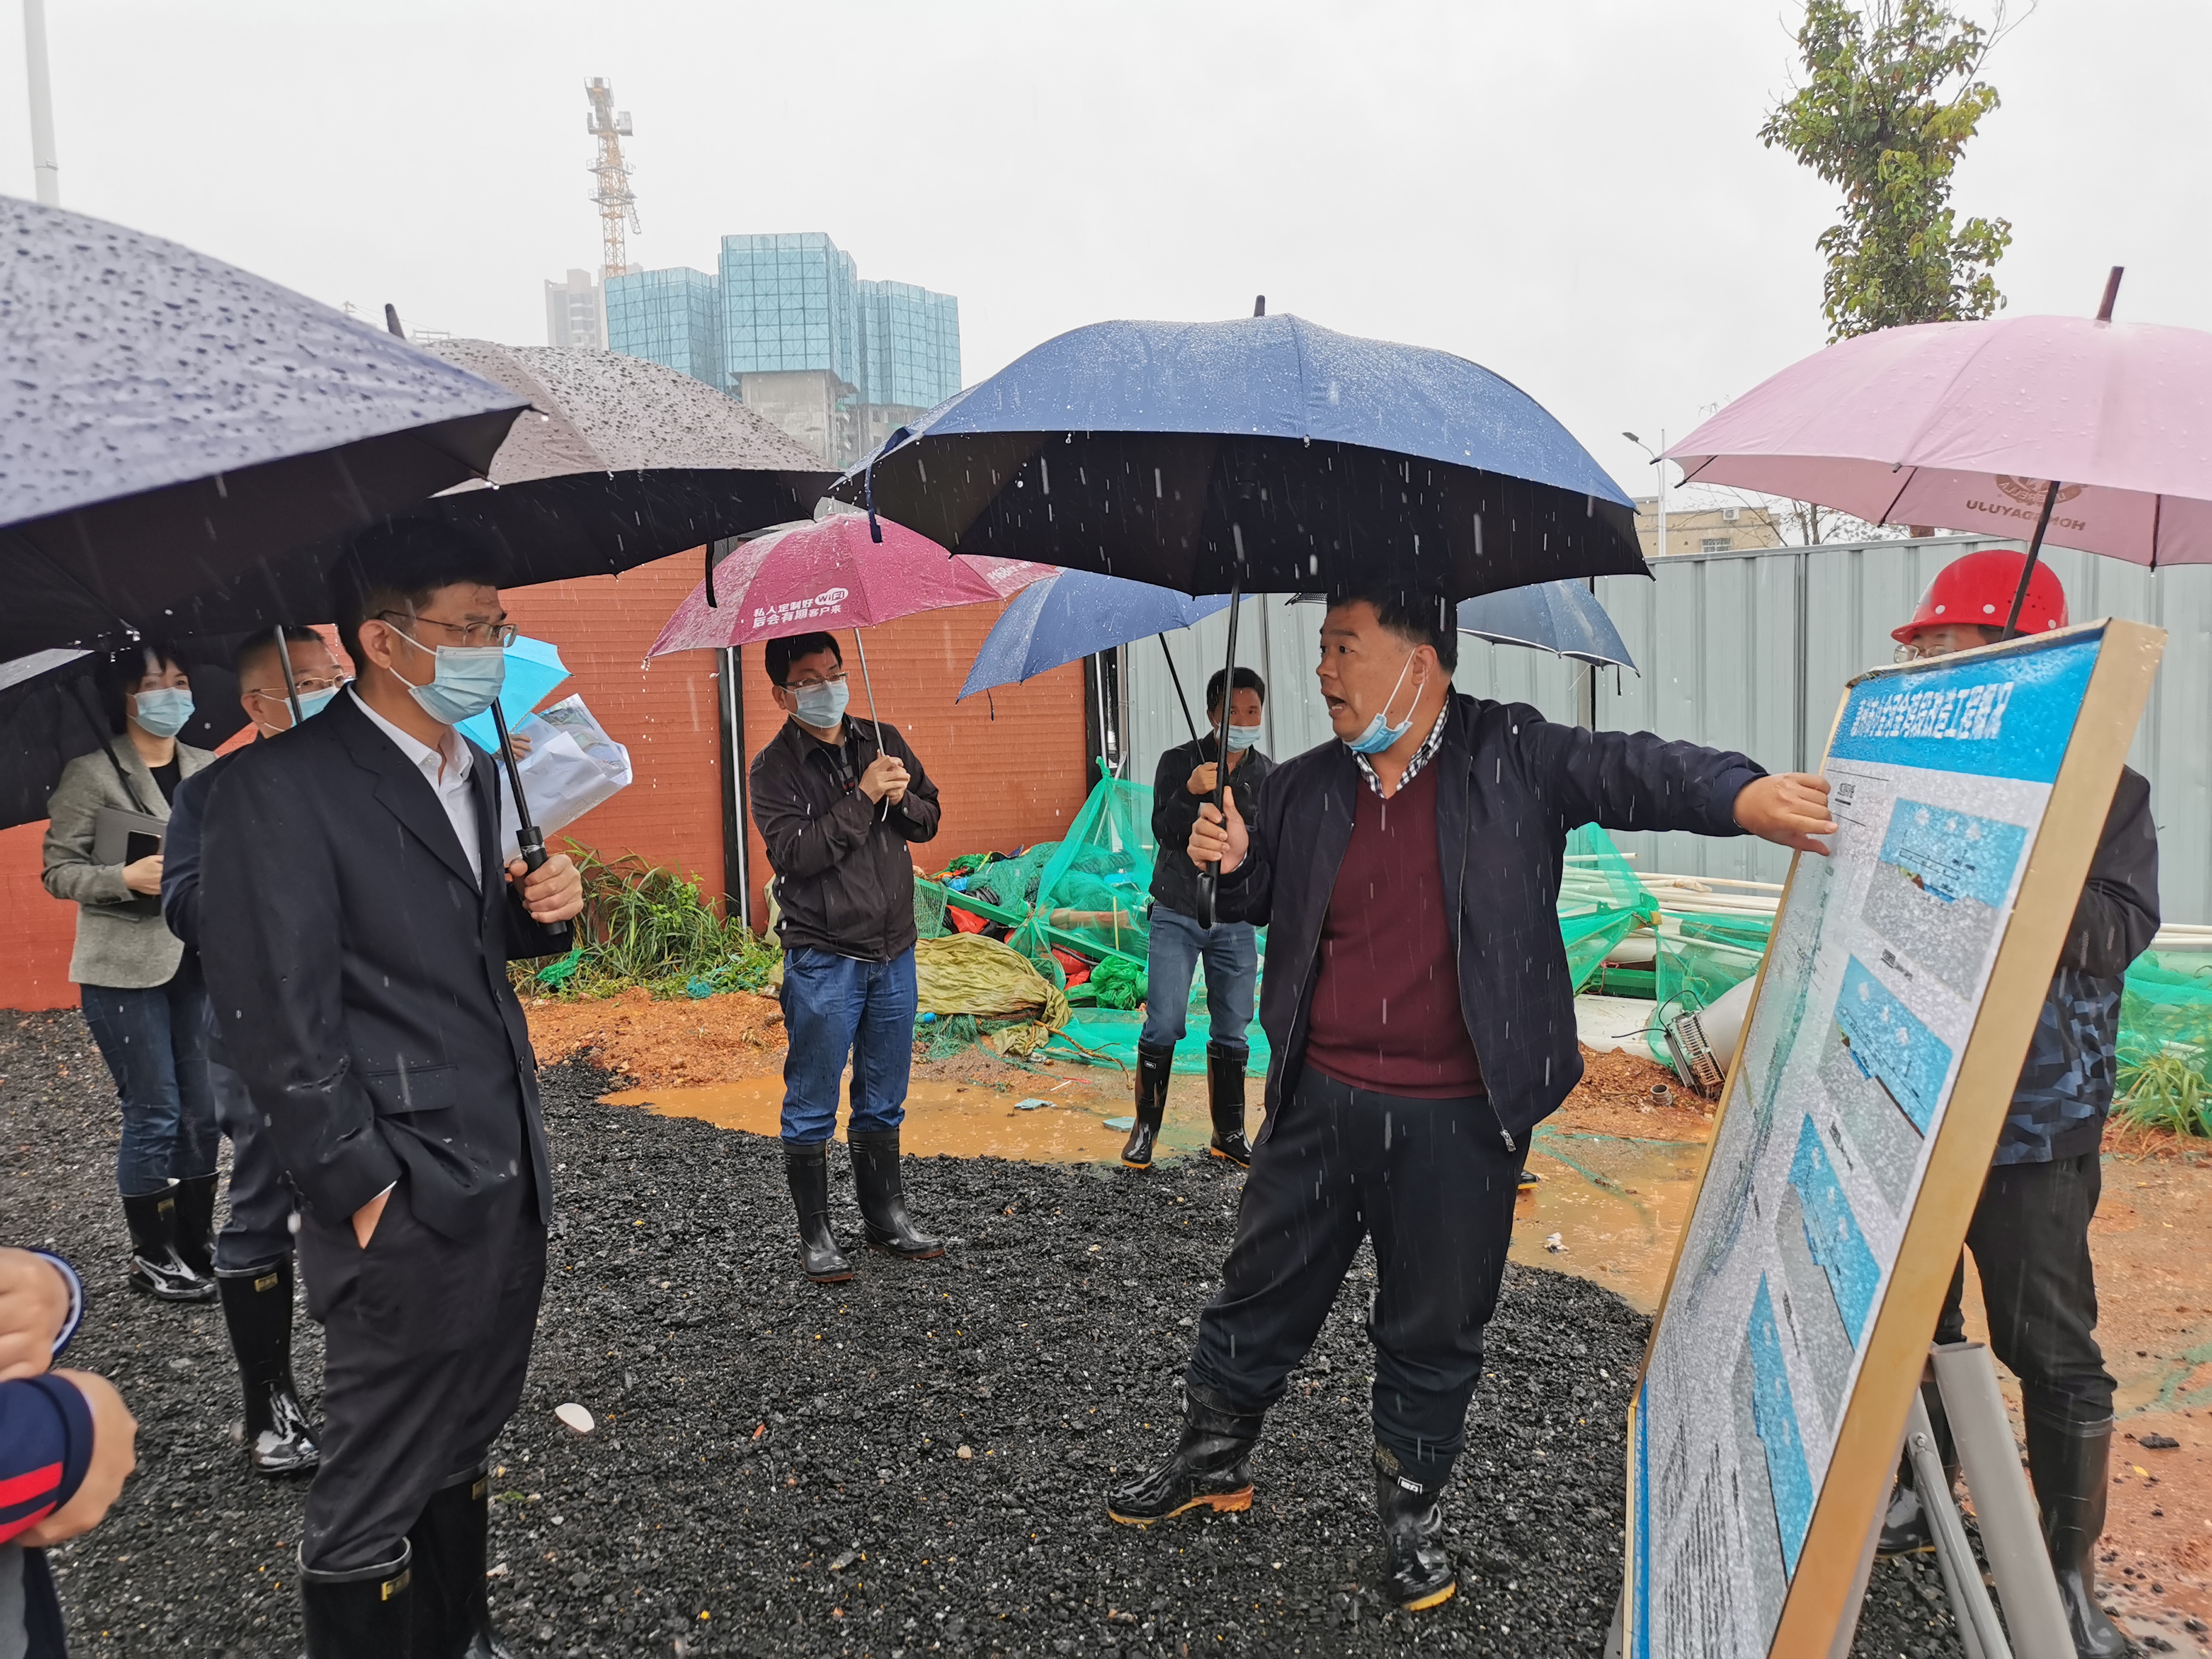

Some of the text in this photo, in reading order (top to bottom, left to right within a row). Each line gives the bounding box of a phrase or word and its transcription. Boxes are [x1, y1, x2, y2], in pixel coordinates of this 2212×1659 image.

[752, 605, 842, 628] 后会有期客户来
[754, 598, 814, 617] 私人定制好
